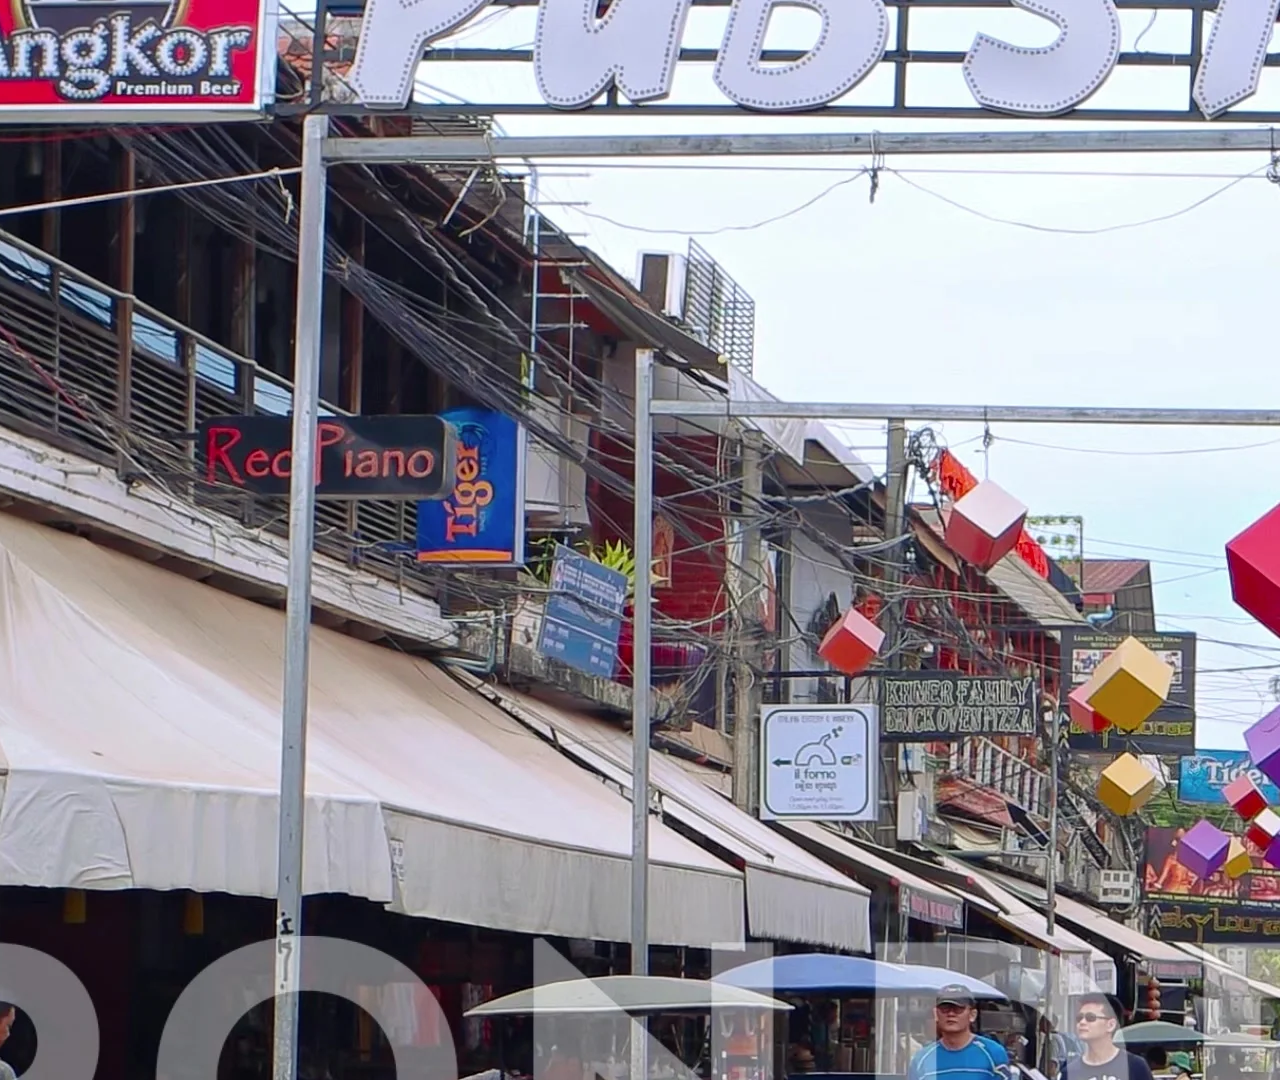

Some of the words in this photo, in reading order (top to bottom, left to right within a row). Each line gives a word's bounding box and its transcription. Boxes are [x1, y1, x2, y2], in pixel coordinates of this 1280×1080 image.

[115, 80, 195, 97] Premium
[199, 79, 241, 95] Beer
[312, 422, 435, 486] Piano
[443, 440, 495, 544] Tiger
[884, 678, 954, 706] KHMER
[955, 677, 1033, 706] FAMILY
[936, 706, 981, 733] OVEN
[981, 706, 1034, 734] PIZZA
[804, 768, 837, 780] forno
